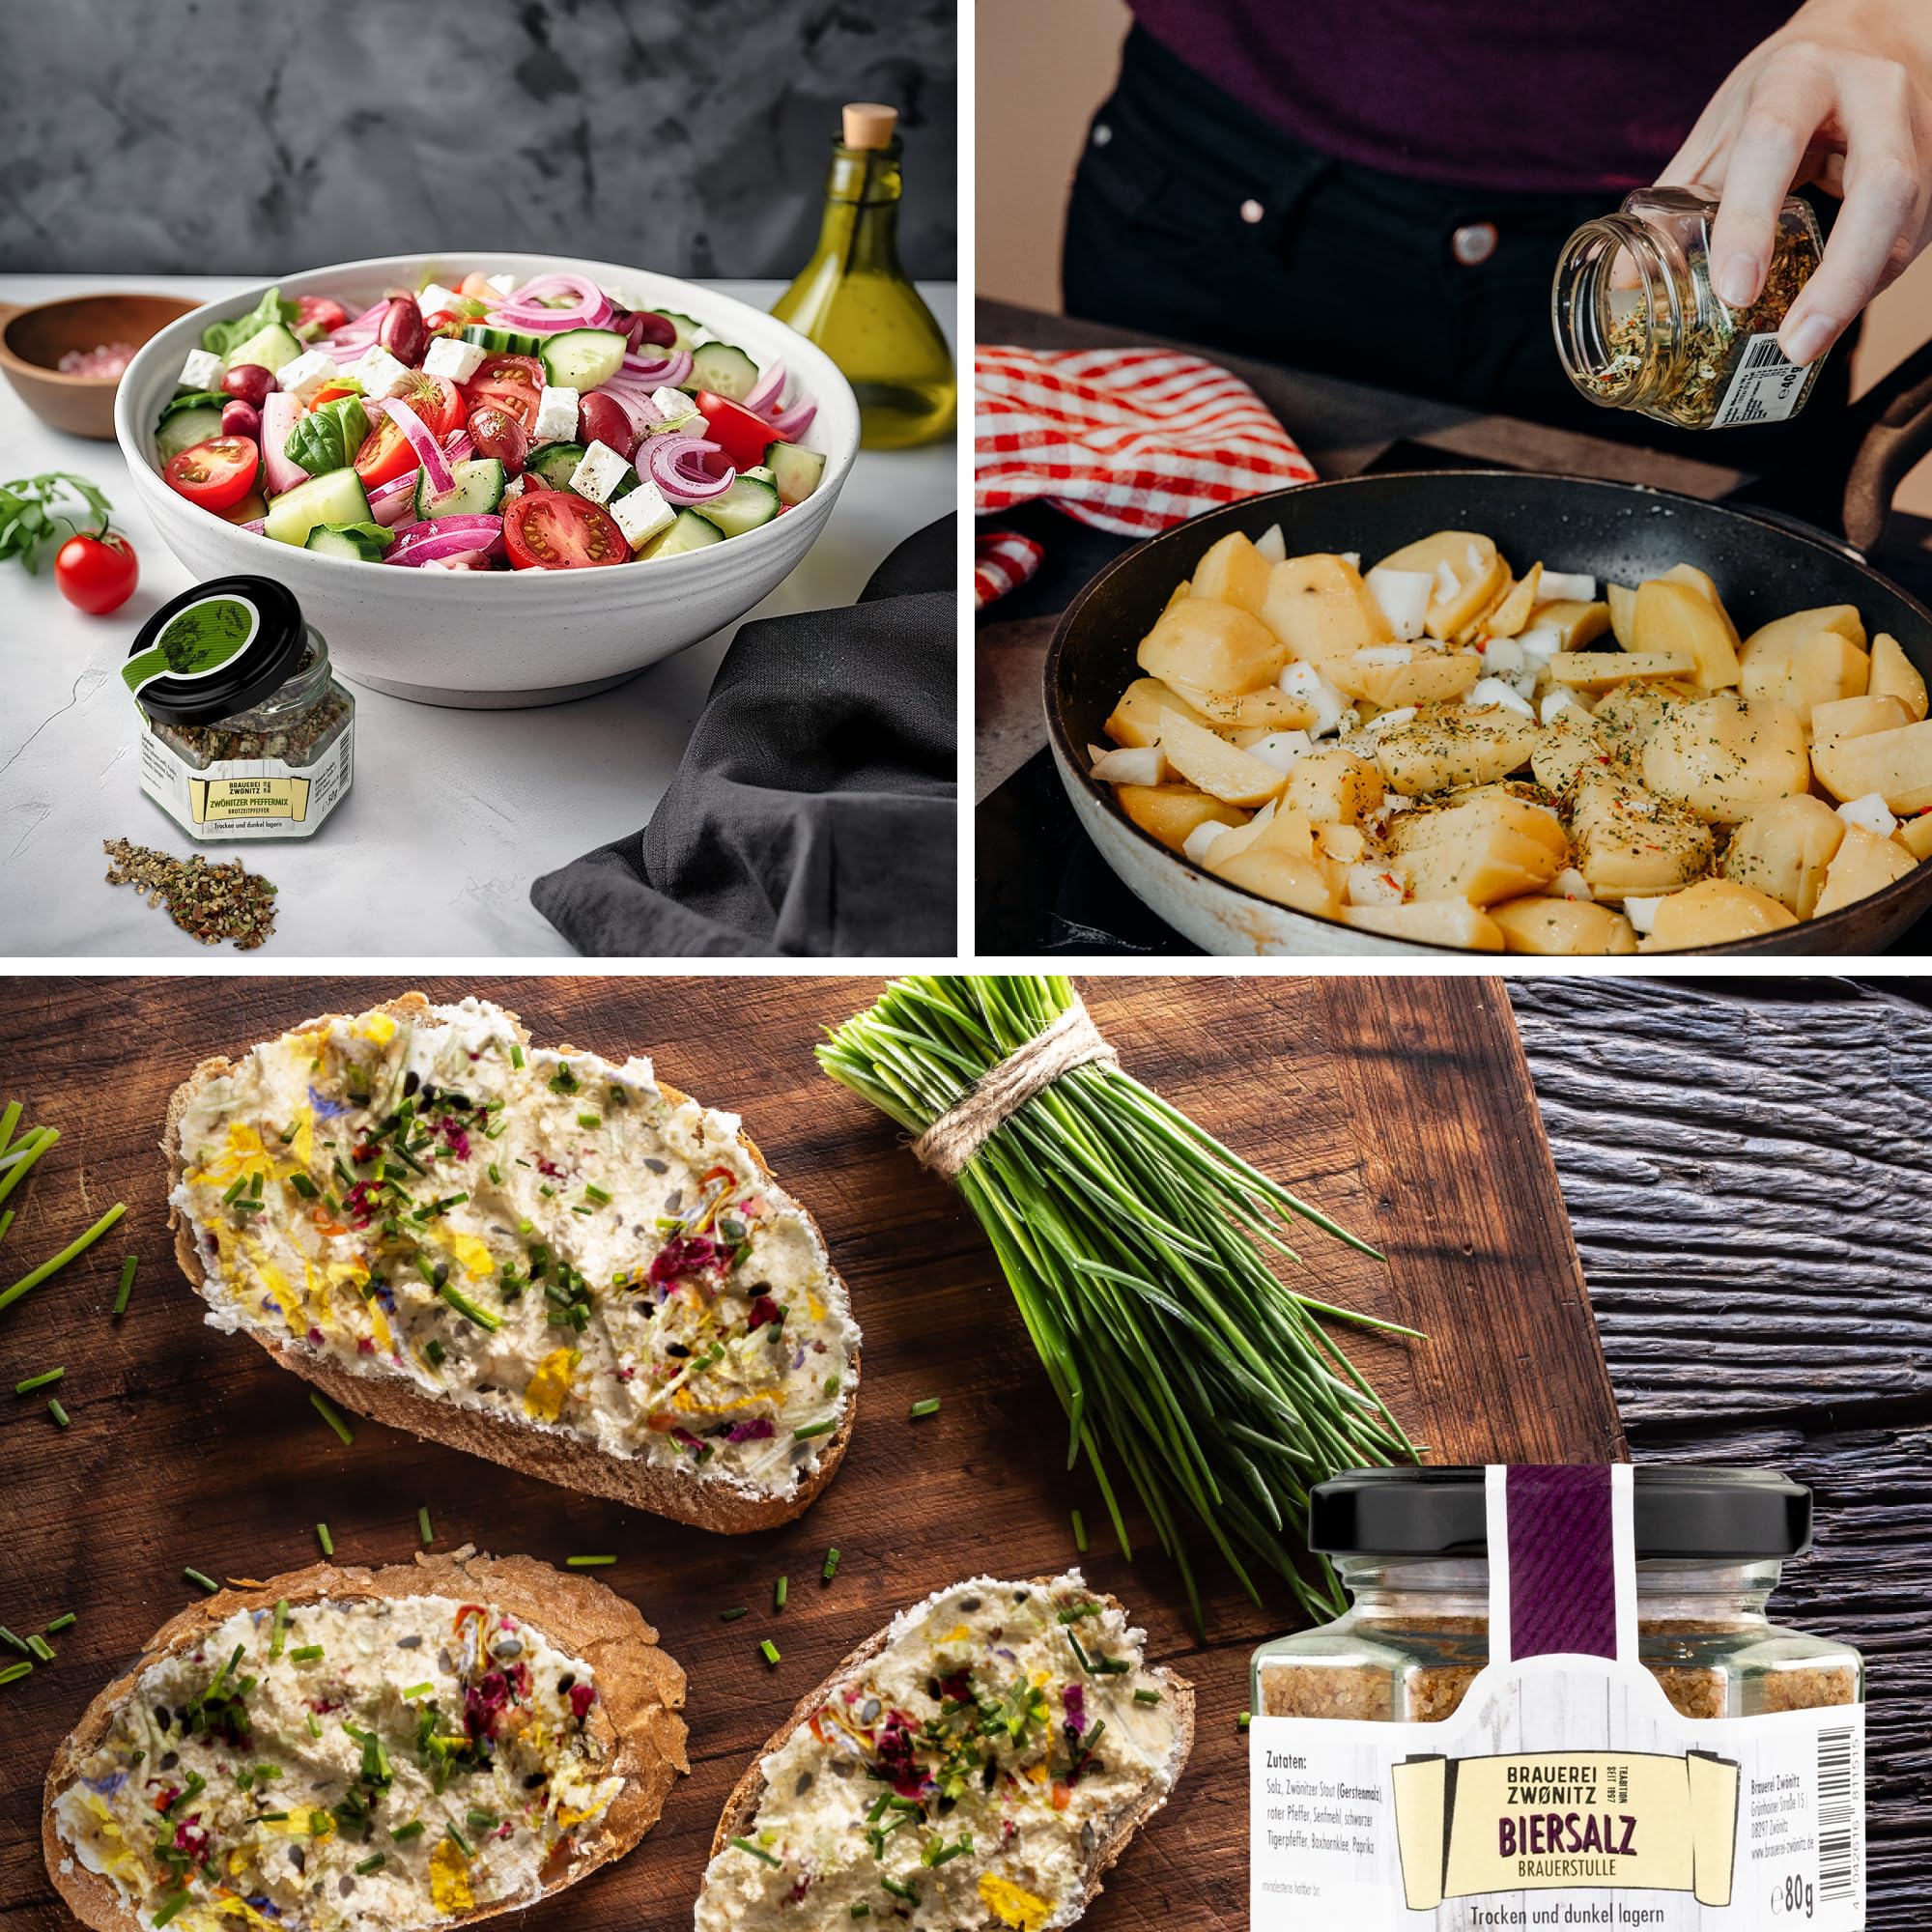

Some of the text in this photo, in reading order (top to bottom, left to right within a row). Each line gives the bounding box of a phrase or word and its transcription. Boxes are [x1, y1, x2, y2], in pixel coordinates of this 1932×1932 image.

[210, 798, 289, 809] ZWÖNITZER PFEFFERMIX
[266, 821, 283, 830] lagern
[1266, 1749, 1307, 1770] Zutaten:
[1507, 1766, 1597, 1783] BRAUEREI
[1606, 1766, 1617, 1782] SEIT
[1751, 1773, 1800, 1795] Brauerei Zwönitz
[1266, 1777, 1285, 1798] Salz,
[1286, 1778, 1319, 1797] Zwönitzer
[1320, 1780, 1336, 1798] Stout
[1779, 1792, 1796, 1812] Straße
[1267, 1803, 1374, 1828] roter Pfeffer, Senfmehl, schwarzer
[1499, 1812, 1638, 1858] BIERSALZ
[1770, 1817, 1788, 1836] Zwönitz
[1267, 1829, 1310, 1851] Tigerpfeffer,
[1352, 1835, 1375, 1857] Paprika
[1519, 1859, 1617, 1877] BRAUERSTULLE
[1470, 1902, 1664, 1928] Trocken und dunkel lagern
